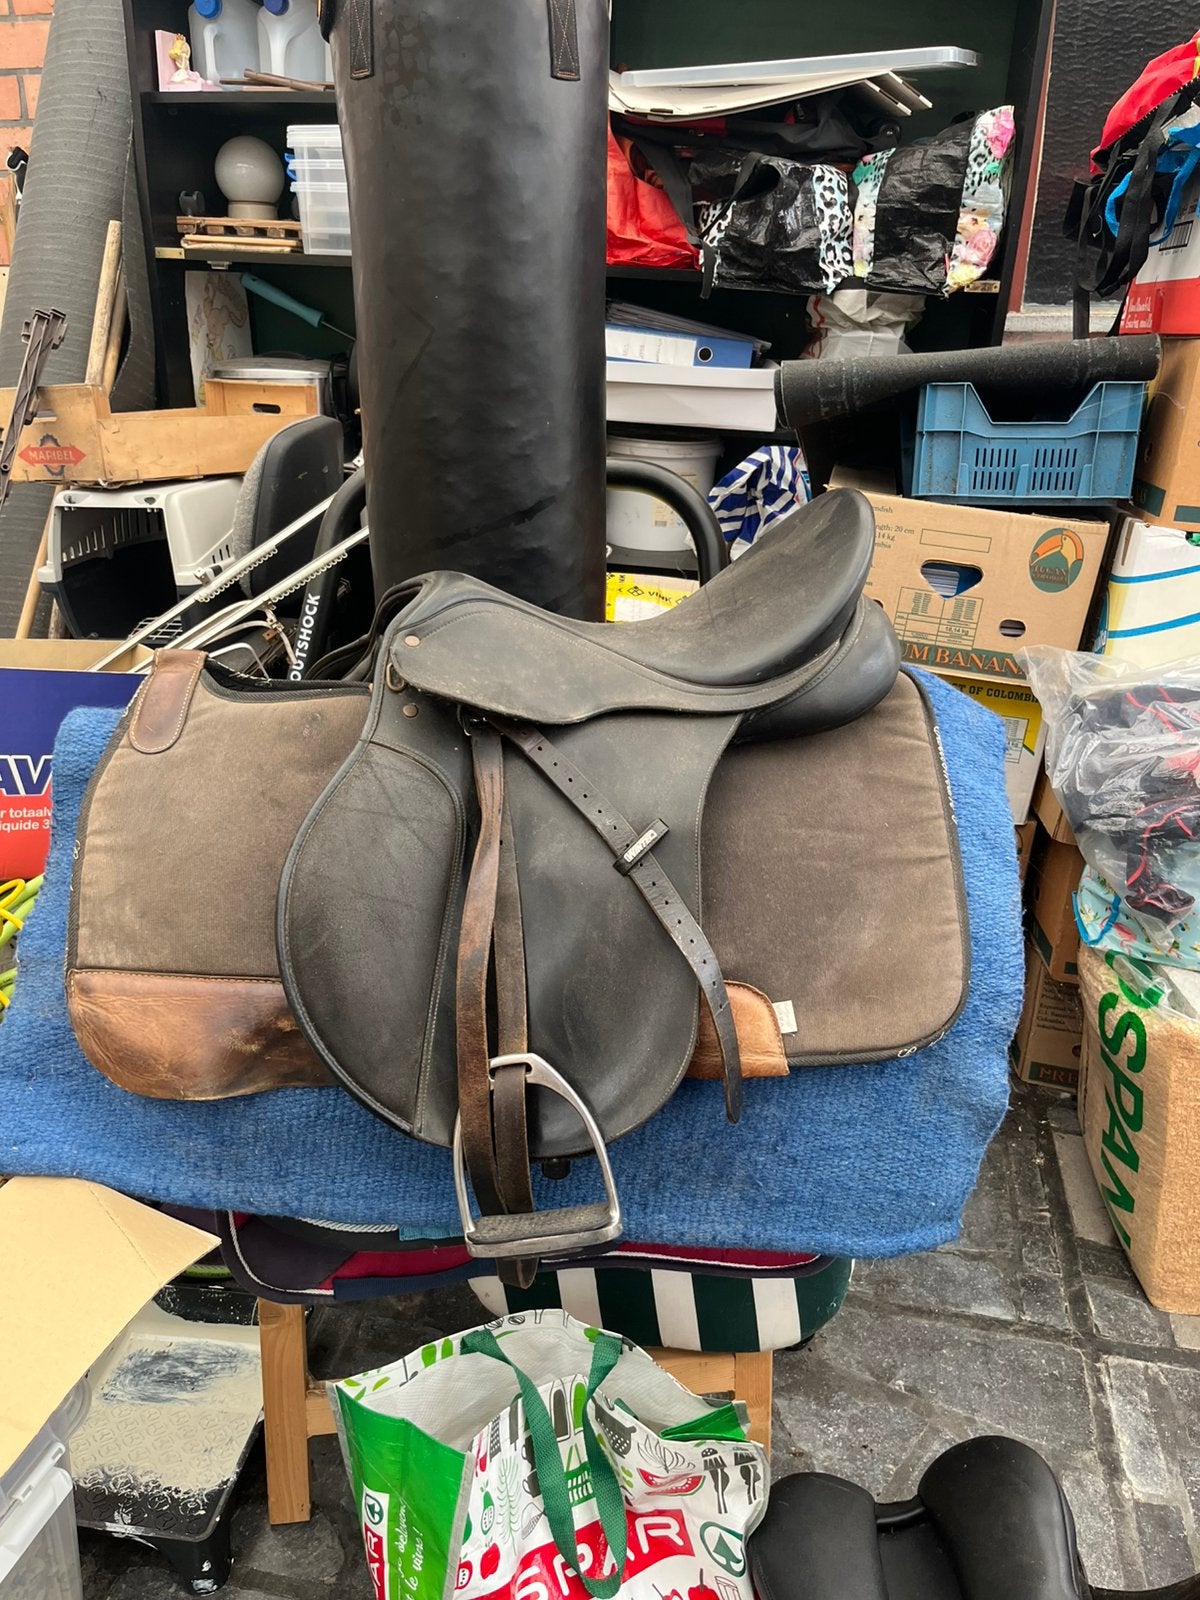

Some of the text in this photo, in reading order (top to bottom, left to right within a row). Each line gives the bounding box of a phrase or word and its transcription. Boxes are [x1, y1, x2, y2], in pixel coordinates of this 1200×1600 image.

[27, 449, 74, 461] MARIBEL
[648, 591, 672, 604] VINK
[936, 648, 1023, 675] BANAN
[969, 685, 983, 695] OF
[986, 688, 1038, 704] COLOMBI
